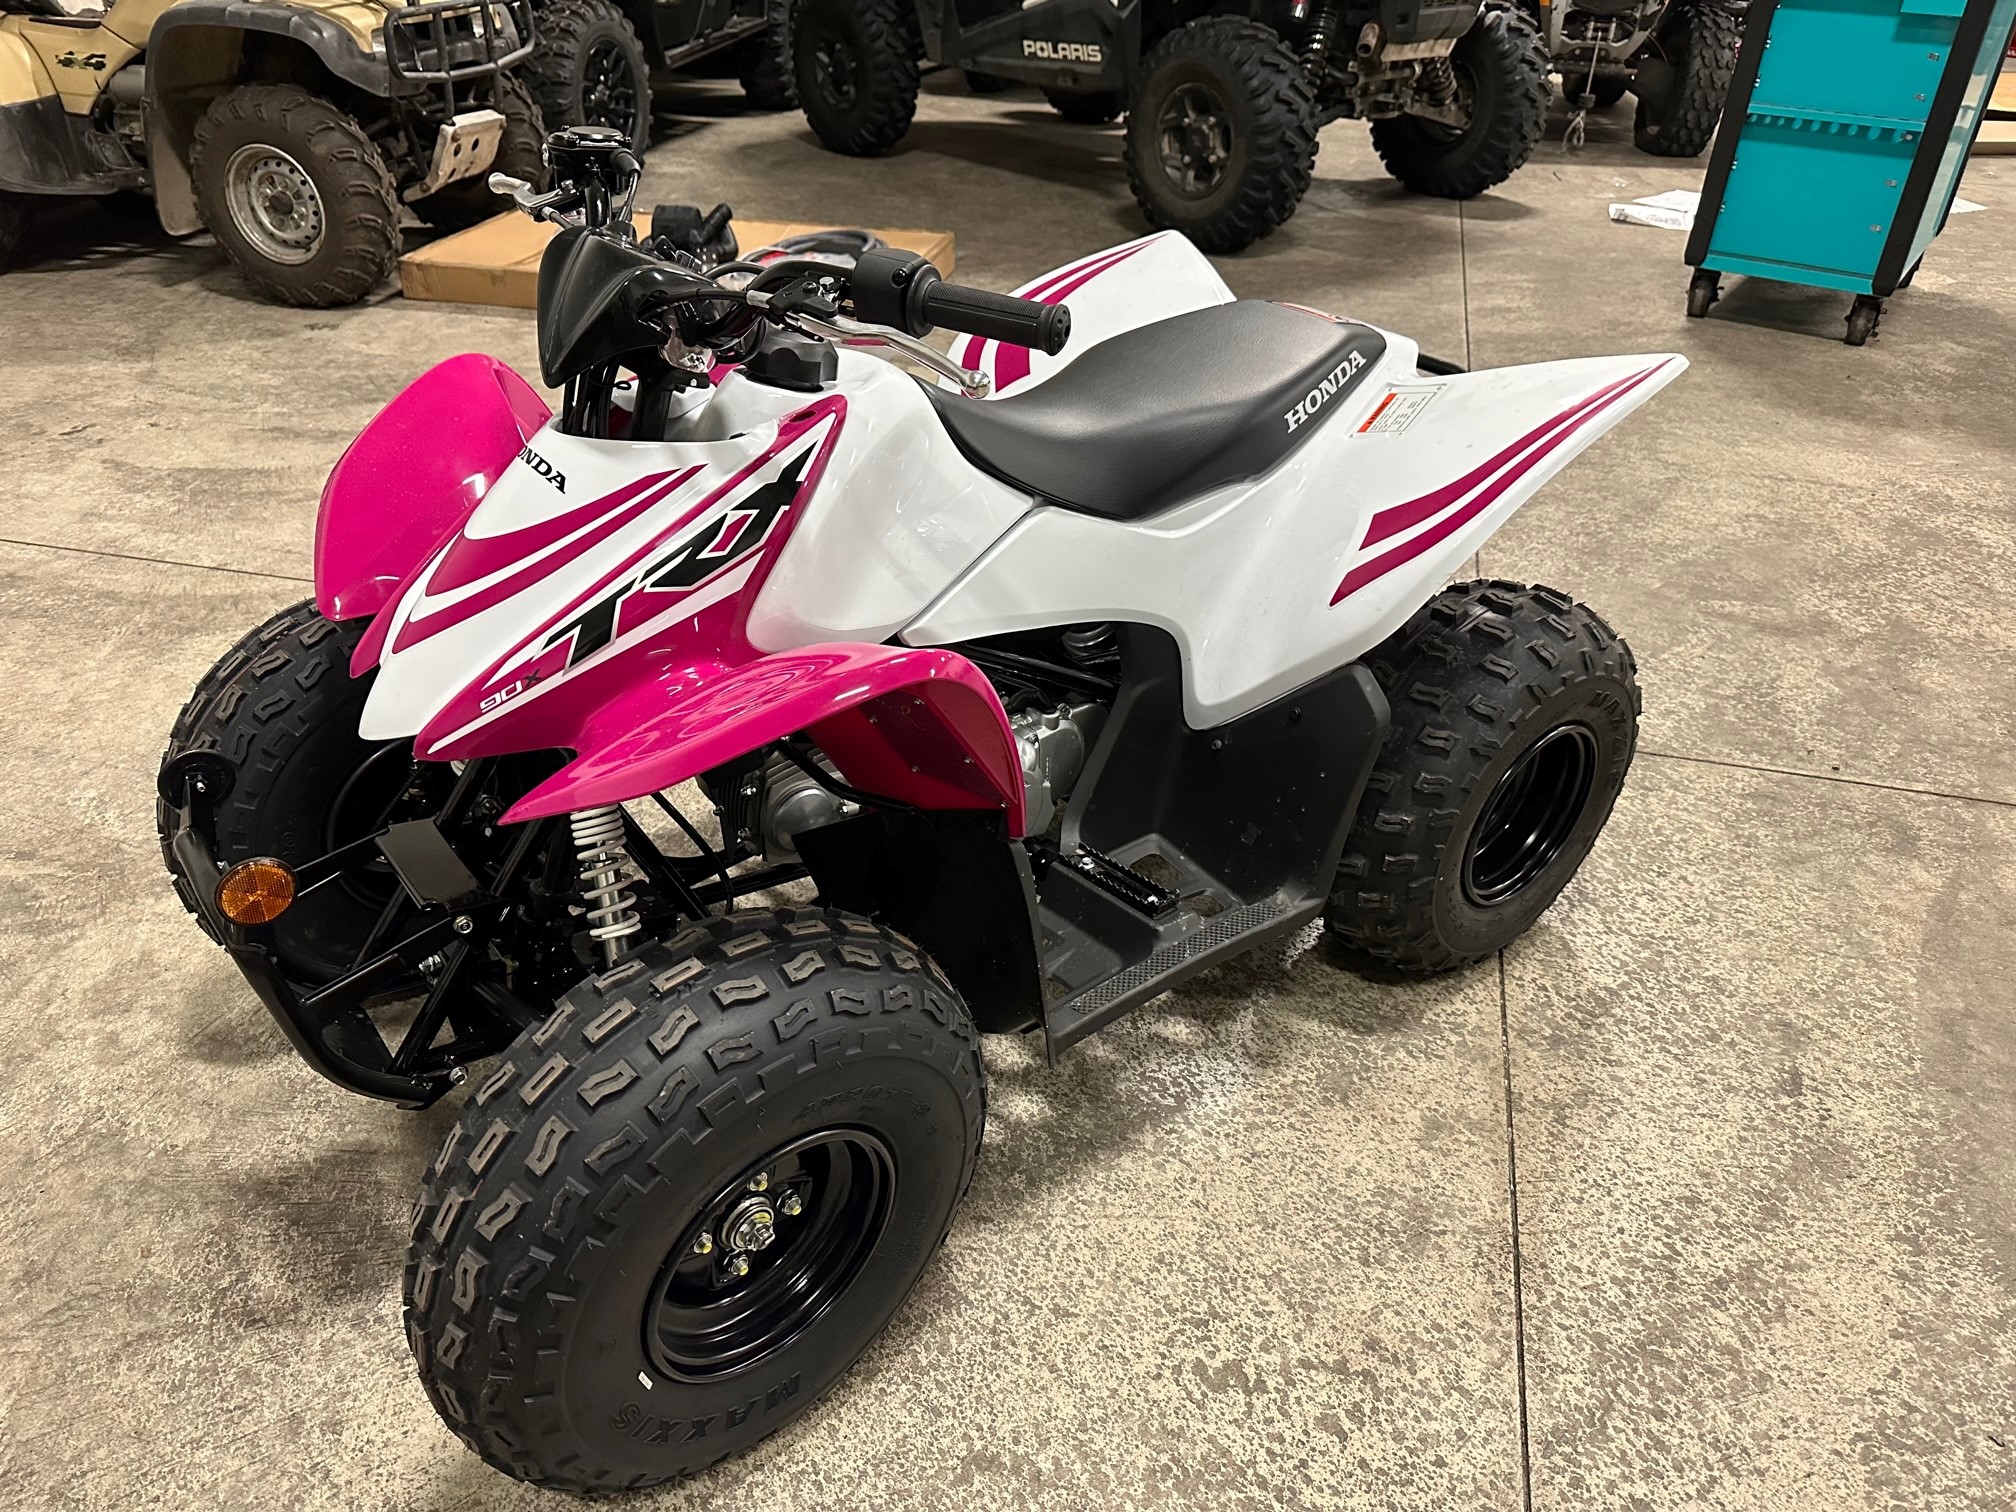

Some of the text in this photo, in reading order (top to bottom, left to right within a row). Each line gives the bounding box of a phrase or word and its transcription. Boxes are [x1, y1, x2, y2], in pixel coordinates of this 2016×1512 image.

[1022, 39, 1102, 62] POLARIS
[1285, 350, 1367, 433] HONDA
[518, 445, 567, 495] NDA
[541, 439, 803, 669] TRX
[611, 1371, 802, 1444] MAXXIS
